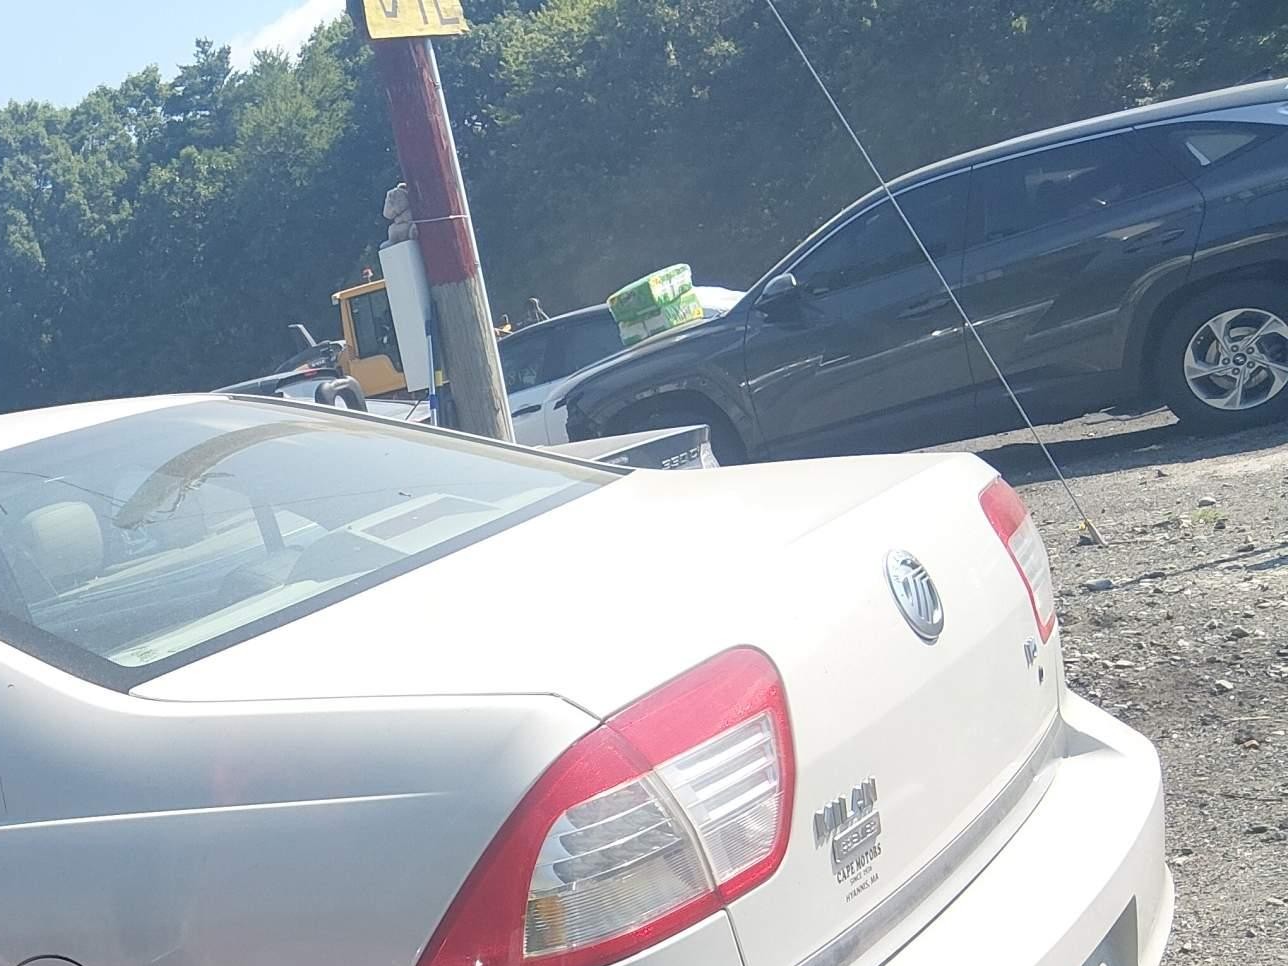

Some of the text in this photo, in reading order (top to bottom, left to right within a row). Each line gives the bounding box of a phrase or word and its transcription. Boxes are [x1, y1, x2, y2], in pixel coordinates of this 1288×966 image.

[813, 777, 877, 847] MILAN
[836, 843, 881, 884] CAPE MOTORS
